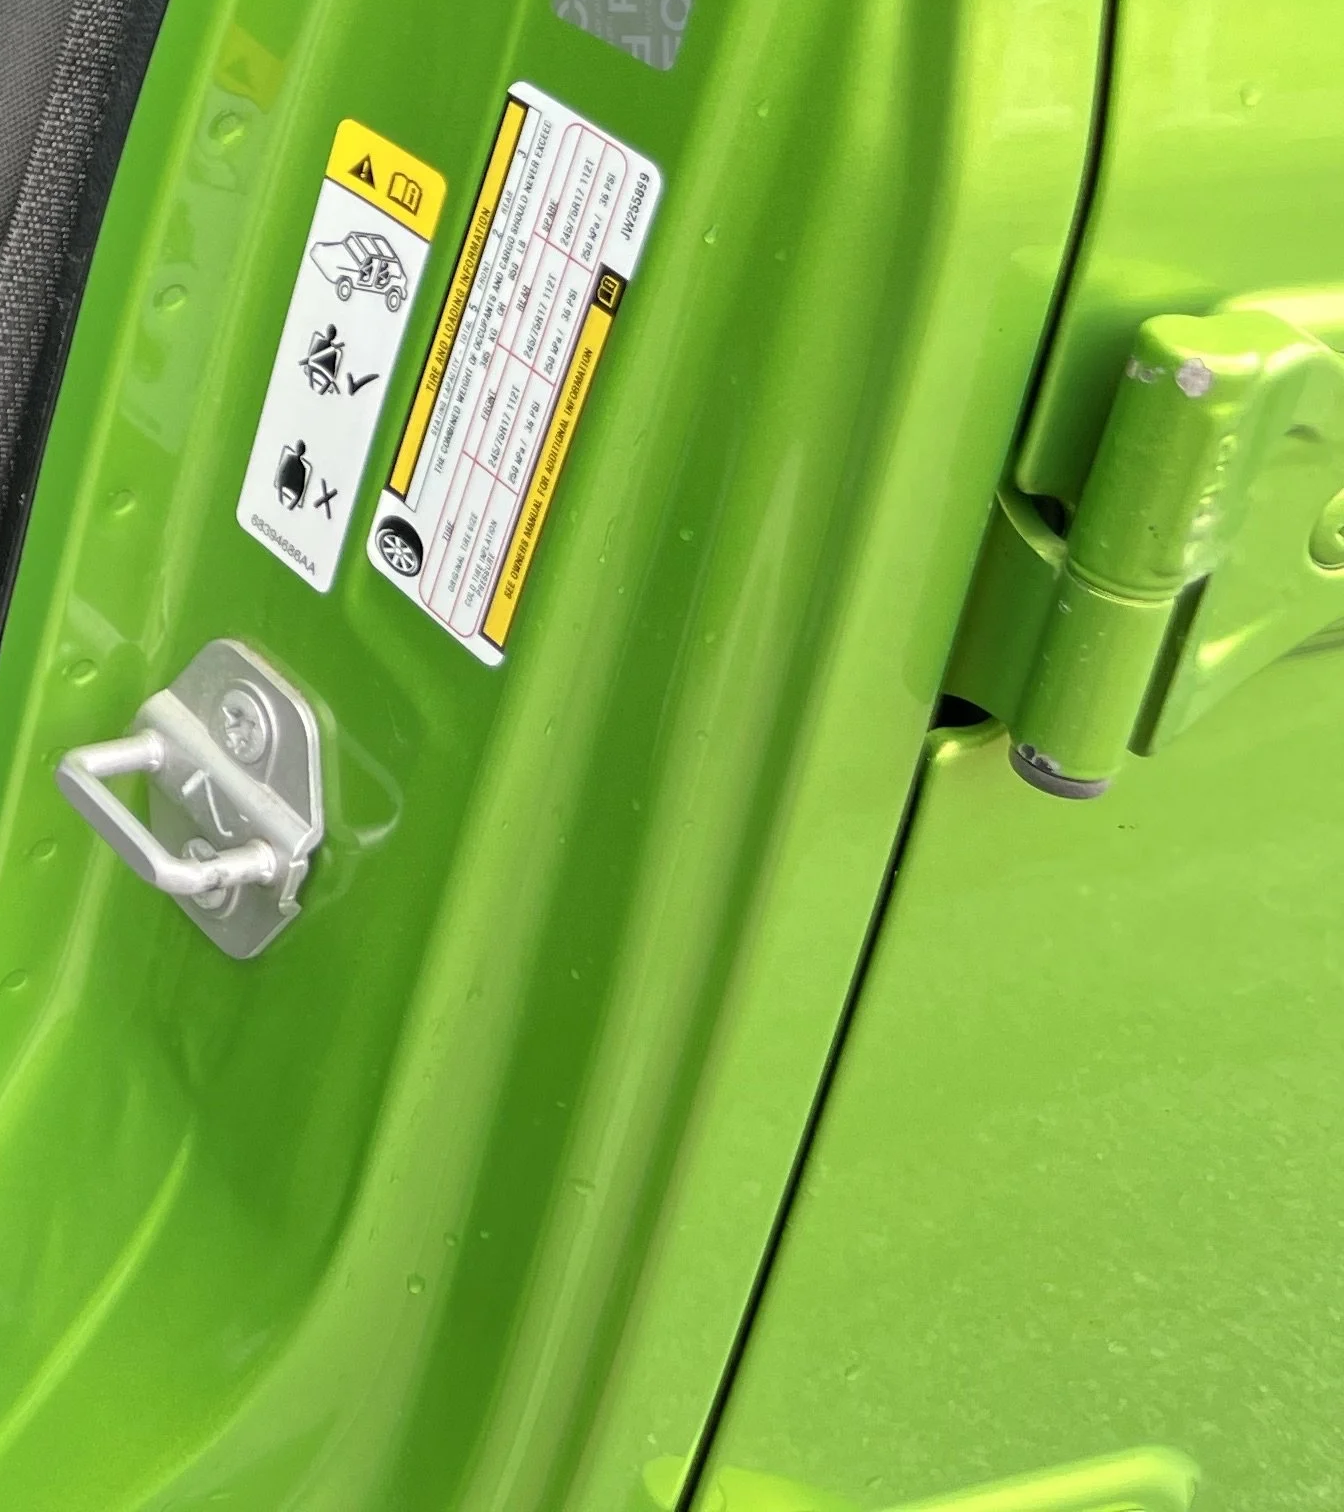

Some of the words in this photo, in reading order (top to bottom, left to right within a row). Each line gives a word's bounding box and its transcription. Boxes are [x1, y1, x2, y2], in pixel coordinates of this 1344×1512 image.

[579, 156, 595, 185] 112T
[603, 171, 616, 192] PSI
[598, 191, 609, 207] 36
[619, 170, 650, 241] JW255899
[541, 197, 558, 232] SPARE
[459, 317, 472, 345] TOTAL
[468, 301, 479, 313] 5
[476, 259, 490, 291] FRONT
[491, 227, 502, 239] 2
[500, 189, 513, 215] REAR
[516, 148, 527, 158] 3
[581, 241, 593, 262] 250
[425, 364, 440, 393] TIRE
[434, 338, 448, 365] AND
[442, 286, 465, 339] LOADING
[458, 205, 491, 288] INFORMATION
[433, 453, 445, 474] THE
[440, 404, 461, 455] COMBINED
[455, 366, 473, 404] WEIGHT
[467, 351, 477, 366] OF
[472, 292, 496, 351] OCCUPANTS
[491, 270, 503, 293] AND
[498, 234, 515, 270] CARGO
[509, 193, 528, 235] SHOULD
[522, 158, 539, 194] NEVER
[533, 118, 552, 159] EXCEED
[487, 326, 497, 343] KG
[516, 239, 526, 254] LB
[515, 283, 530, 312] REAR
[542, 272, 557, 300] 112T
[565, 287, 577, 307] PSI
[560, 307, 571, 322] 36
[543, 354, 555, 375] 250
[480, 387, 496, 421] FRONT
[505, 384, 520, 411] 112T
[528, 400, 540, 419] PSI
[524, 418, 534, 434] 36
[503, 578, 516, 600] SEE
[510, 537, 529, 581] OWNERS
[523, 496, 542, 539] MANUAL
[537, 474, 550, 497] FOR
[544, 416, 569, 475] ADDITIONAL
[563, 345, 592, 417] INFORMATION
[507, 464, 519, 485] 250
[447, 553, 464, 593] ORIGINAL
[460, 531, 471, 552] TIRE
[464, 583, 476, 608] COLD
[471, 562, 483, 583] TIRE
[478, 517, 497, 563] INFLATION
